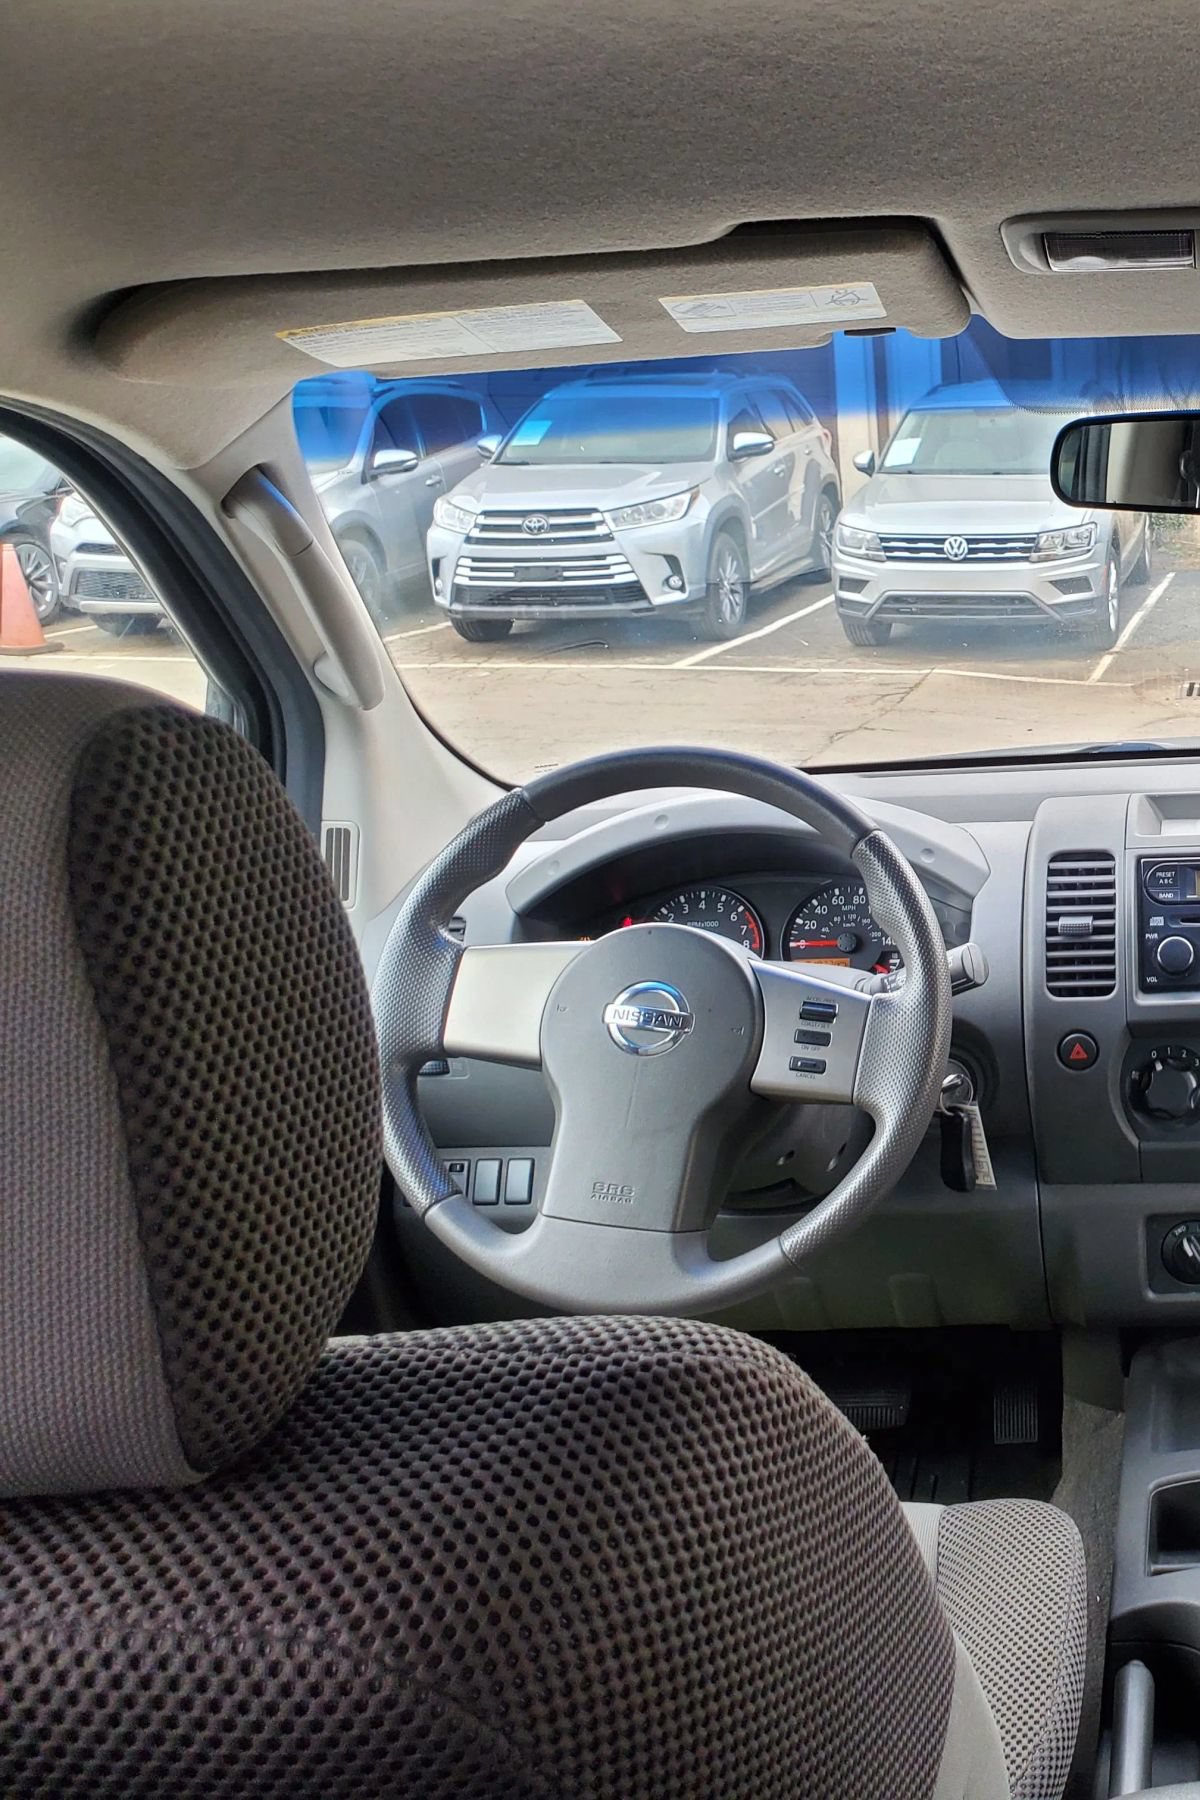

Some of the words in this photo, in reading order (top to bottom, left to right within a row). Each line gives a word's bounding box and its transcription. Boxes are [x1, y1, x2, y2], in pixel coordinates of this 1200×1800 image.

[699, 900, 706, 910] 4
[831, 896, 845, 905] 60
[852, 895, 866, 904] 80
[682, 903, 689, 914] 3
[717, 903, 724, 913] 5
[814, 905, 828, 914] 40
[668, 913, 674, 923] 2
[730, 912, 738, 922] 6
[740, 925, 747, 935] 7
[804, 920, 817, 930] 20
[743, 940, 750, 949] 8
[613, 1008, 683, 1028] NISSAN
[1151, 1050, 1157, 1058] 0
[1167, 1046, 1171, 1055] 1
[1181, 1049, 1187, 1058] 2
[1194, 1057, 1200, 1067] 3
